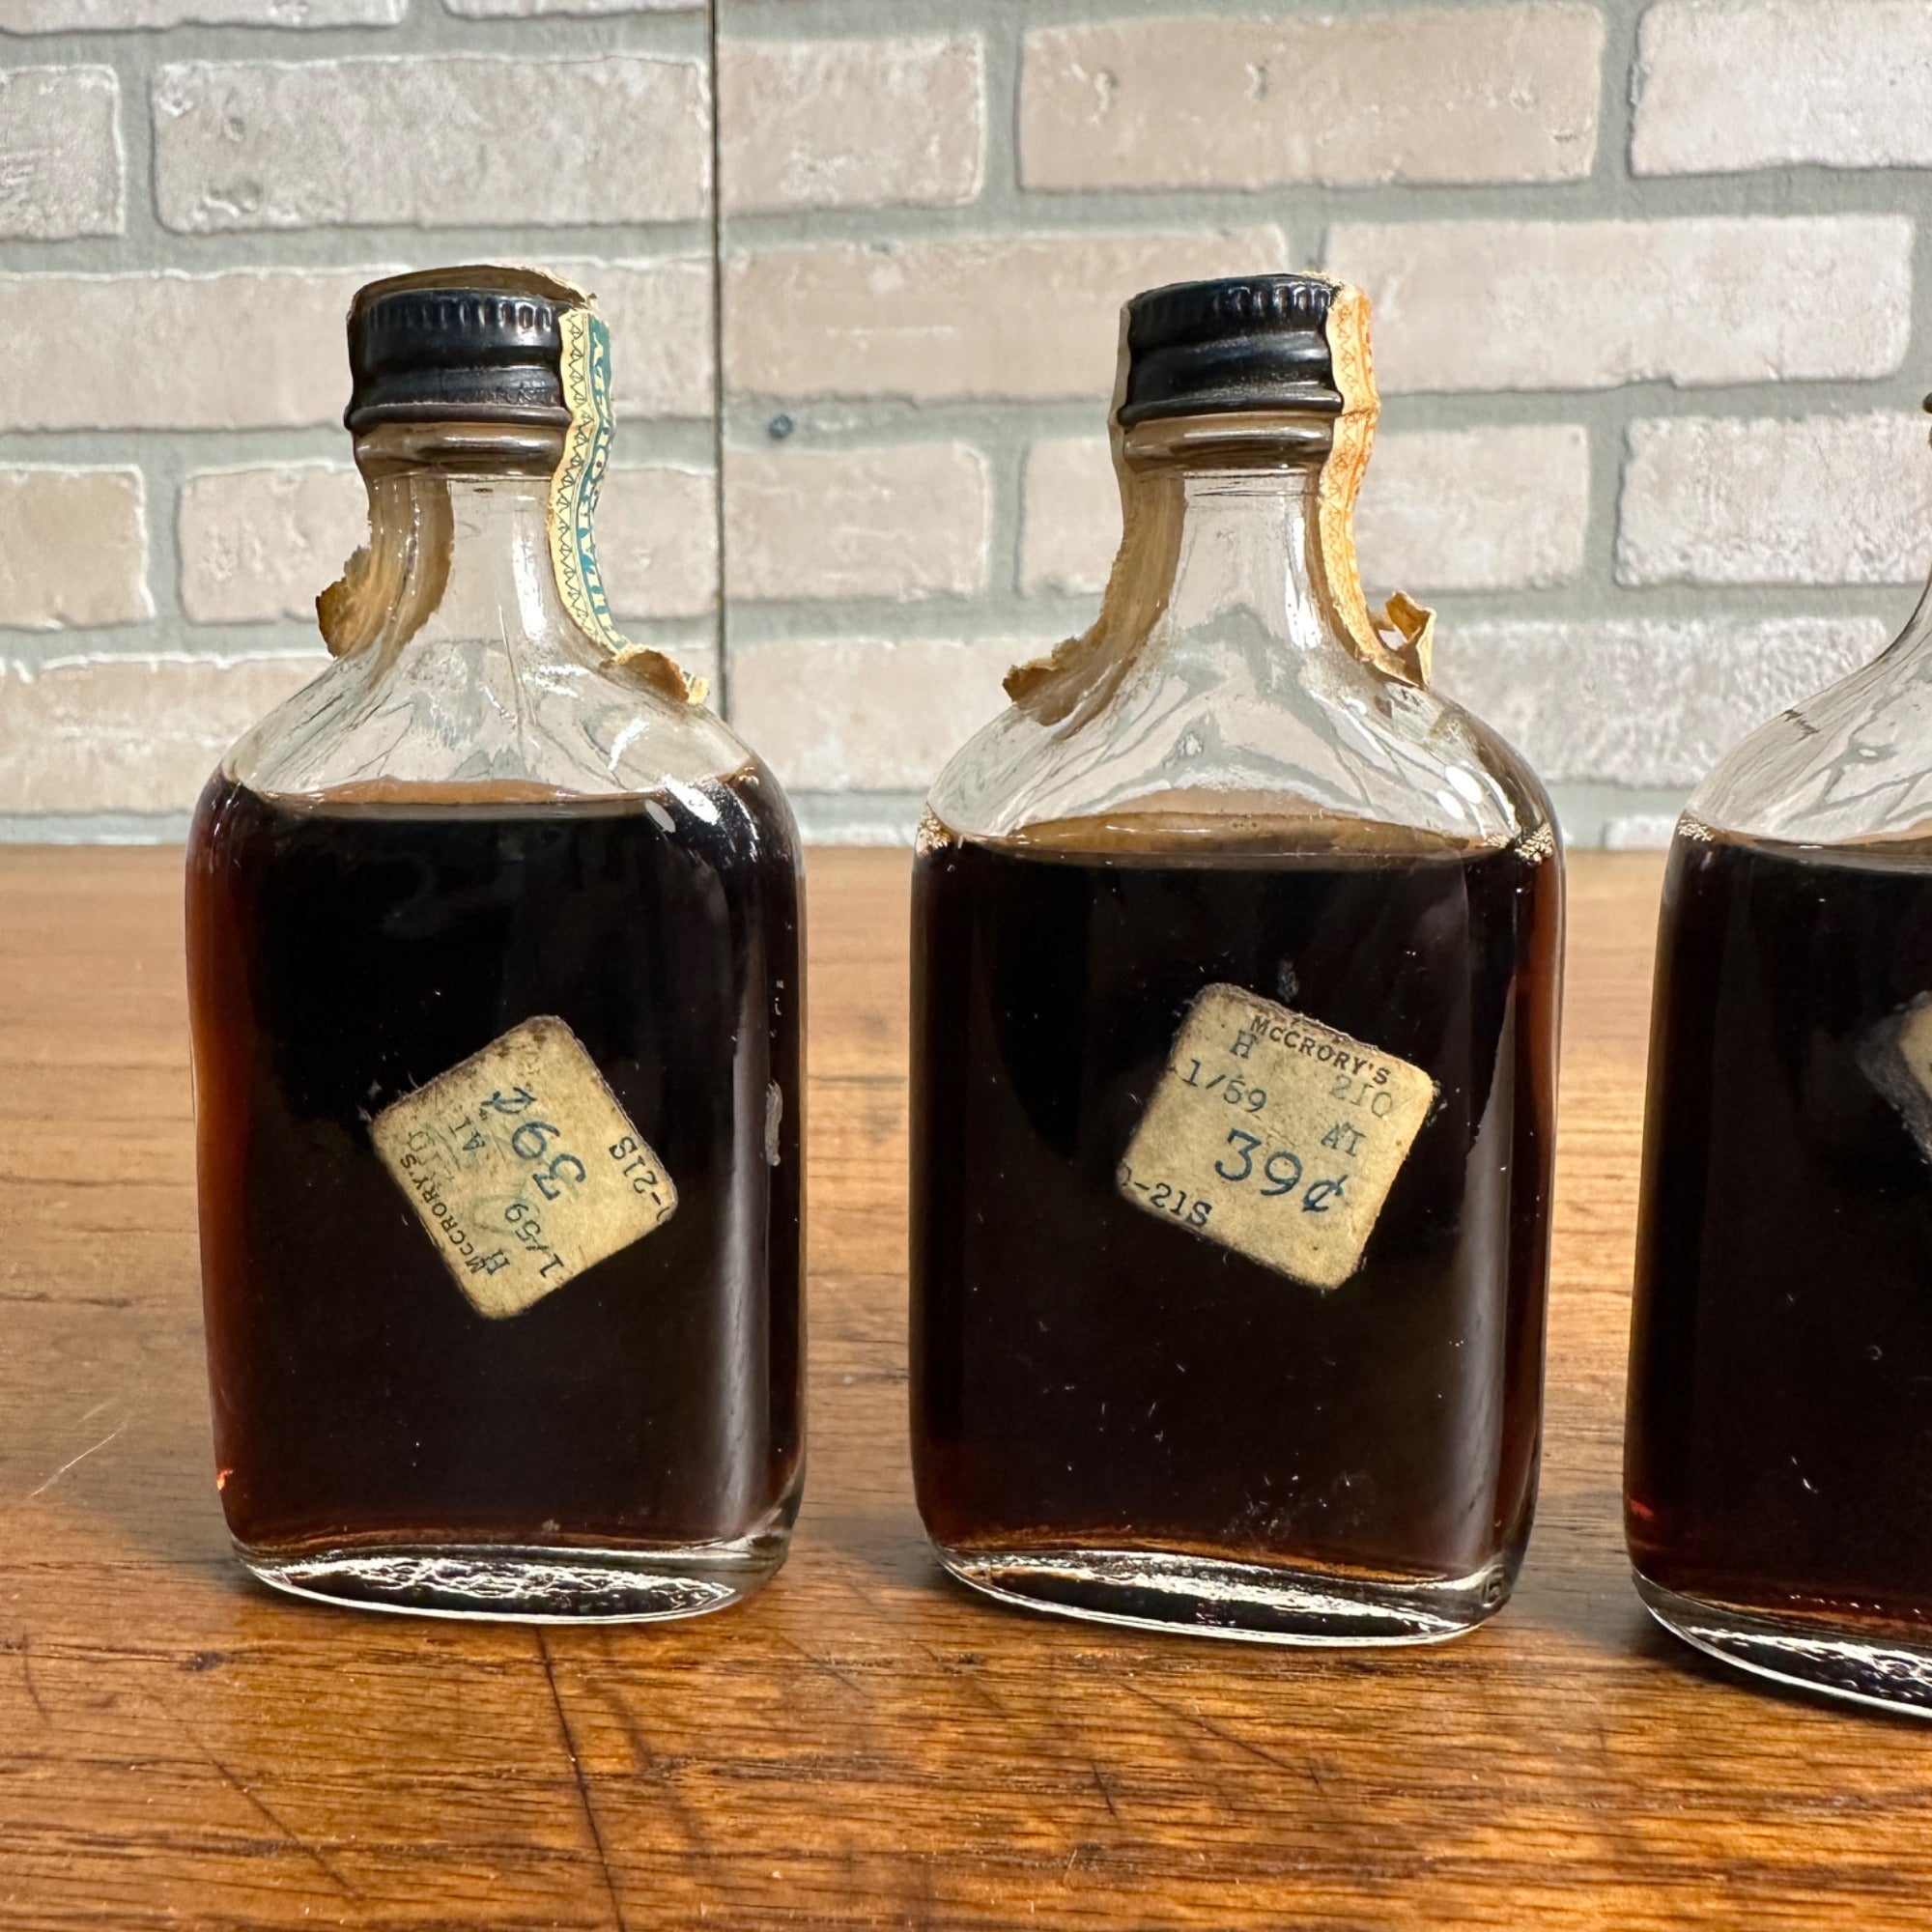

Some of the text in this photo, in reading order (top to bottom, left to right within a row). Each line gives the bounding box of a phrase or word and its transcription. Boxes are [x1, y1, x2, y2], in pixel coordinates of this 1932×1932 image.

[1230, 1030, 1259, 1059] H
[481, 1086, 586, 1201] 39¢
[1214, 1127, 1349, 1213] 39¢
[503, 1203, 565, 1278] 1/59
